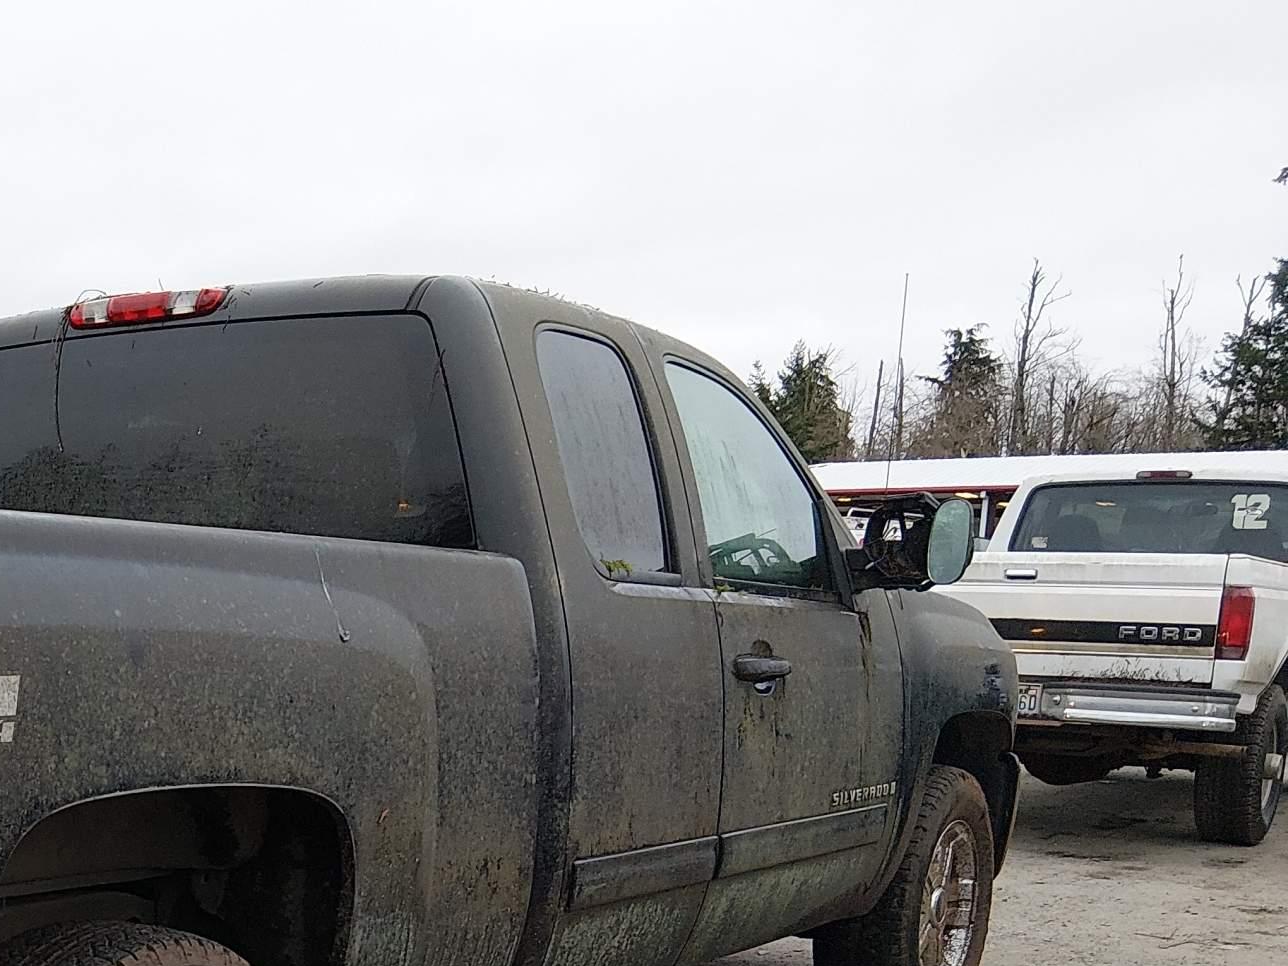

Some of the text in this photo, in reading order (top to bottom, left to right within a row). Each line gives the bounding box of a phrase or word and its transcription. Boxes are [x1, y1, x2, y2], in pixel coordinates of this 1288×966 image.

[1231, 494, 1271, 529] 12
[1118, 625, 1202, 641] FORD
[832, 783, 889, 806] SILVERADO
